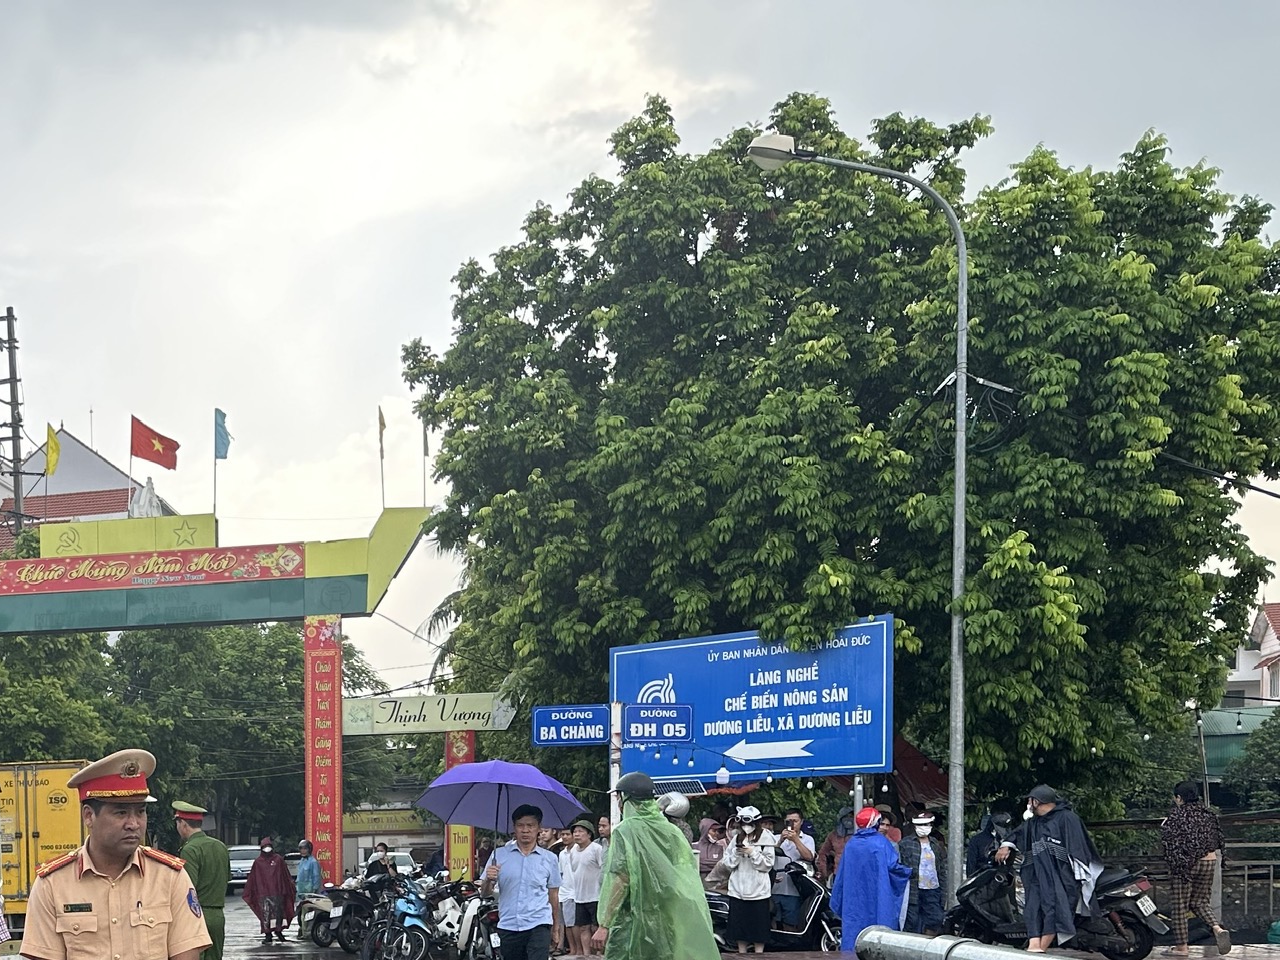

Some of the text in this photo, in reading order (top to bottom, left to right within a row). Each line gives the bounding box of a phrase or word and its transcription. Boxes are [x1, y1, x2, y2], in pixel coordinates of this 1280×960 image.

[16, 552, 237, 586] Chúc Mừng Năm Mới
[722, 650, 740, 660] BAN
[743, 645, 768, 658] NHÂN
[771, 643, 789, 656] DÂN
[826, 635, 848, 649] HOÀI
[851, 632, 871, 646] ĐỨC
[749, 668, 782, 687] LÀNG
[724, 683, 848, 712] CHẾ BIẾN NÔNG SẢN
[376, 697, 492, 727] Thịnh Vượng
[551, 710, 593, 720] ĐƯỜNG
[640, 708, 677, 718] ĐƯỜNG
[703, 722, 743, 737] DƯƠNG
[777, 713, 794, 731] XÃ
[798, 712, 841, 729] DƯƠNG
[844, 705, 872, 725] LIỄU
[540, 722, 604, 740] BA CHÀNG
[630, 723, 687, 737] ĐH 05
[4, 780, 14, 788] XE
[49, 796, 67, 804] ISO
[453, 832, 468, 844] Thìn
[452, 858, 469, 870] 2024
